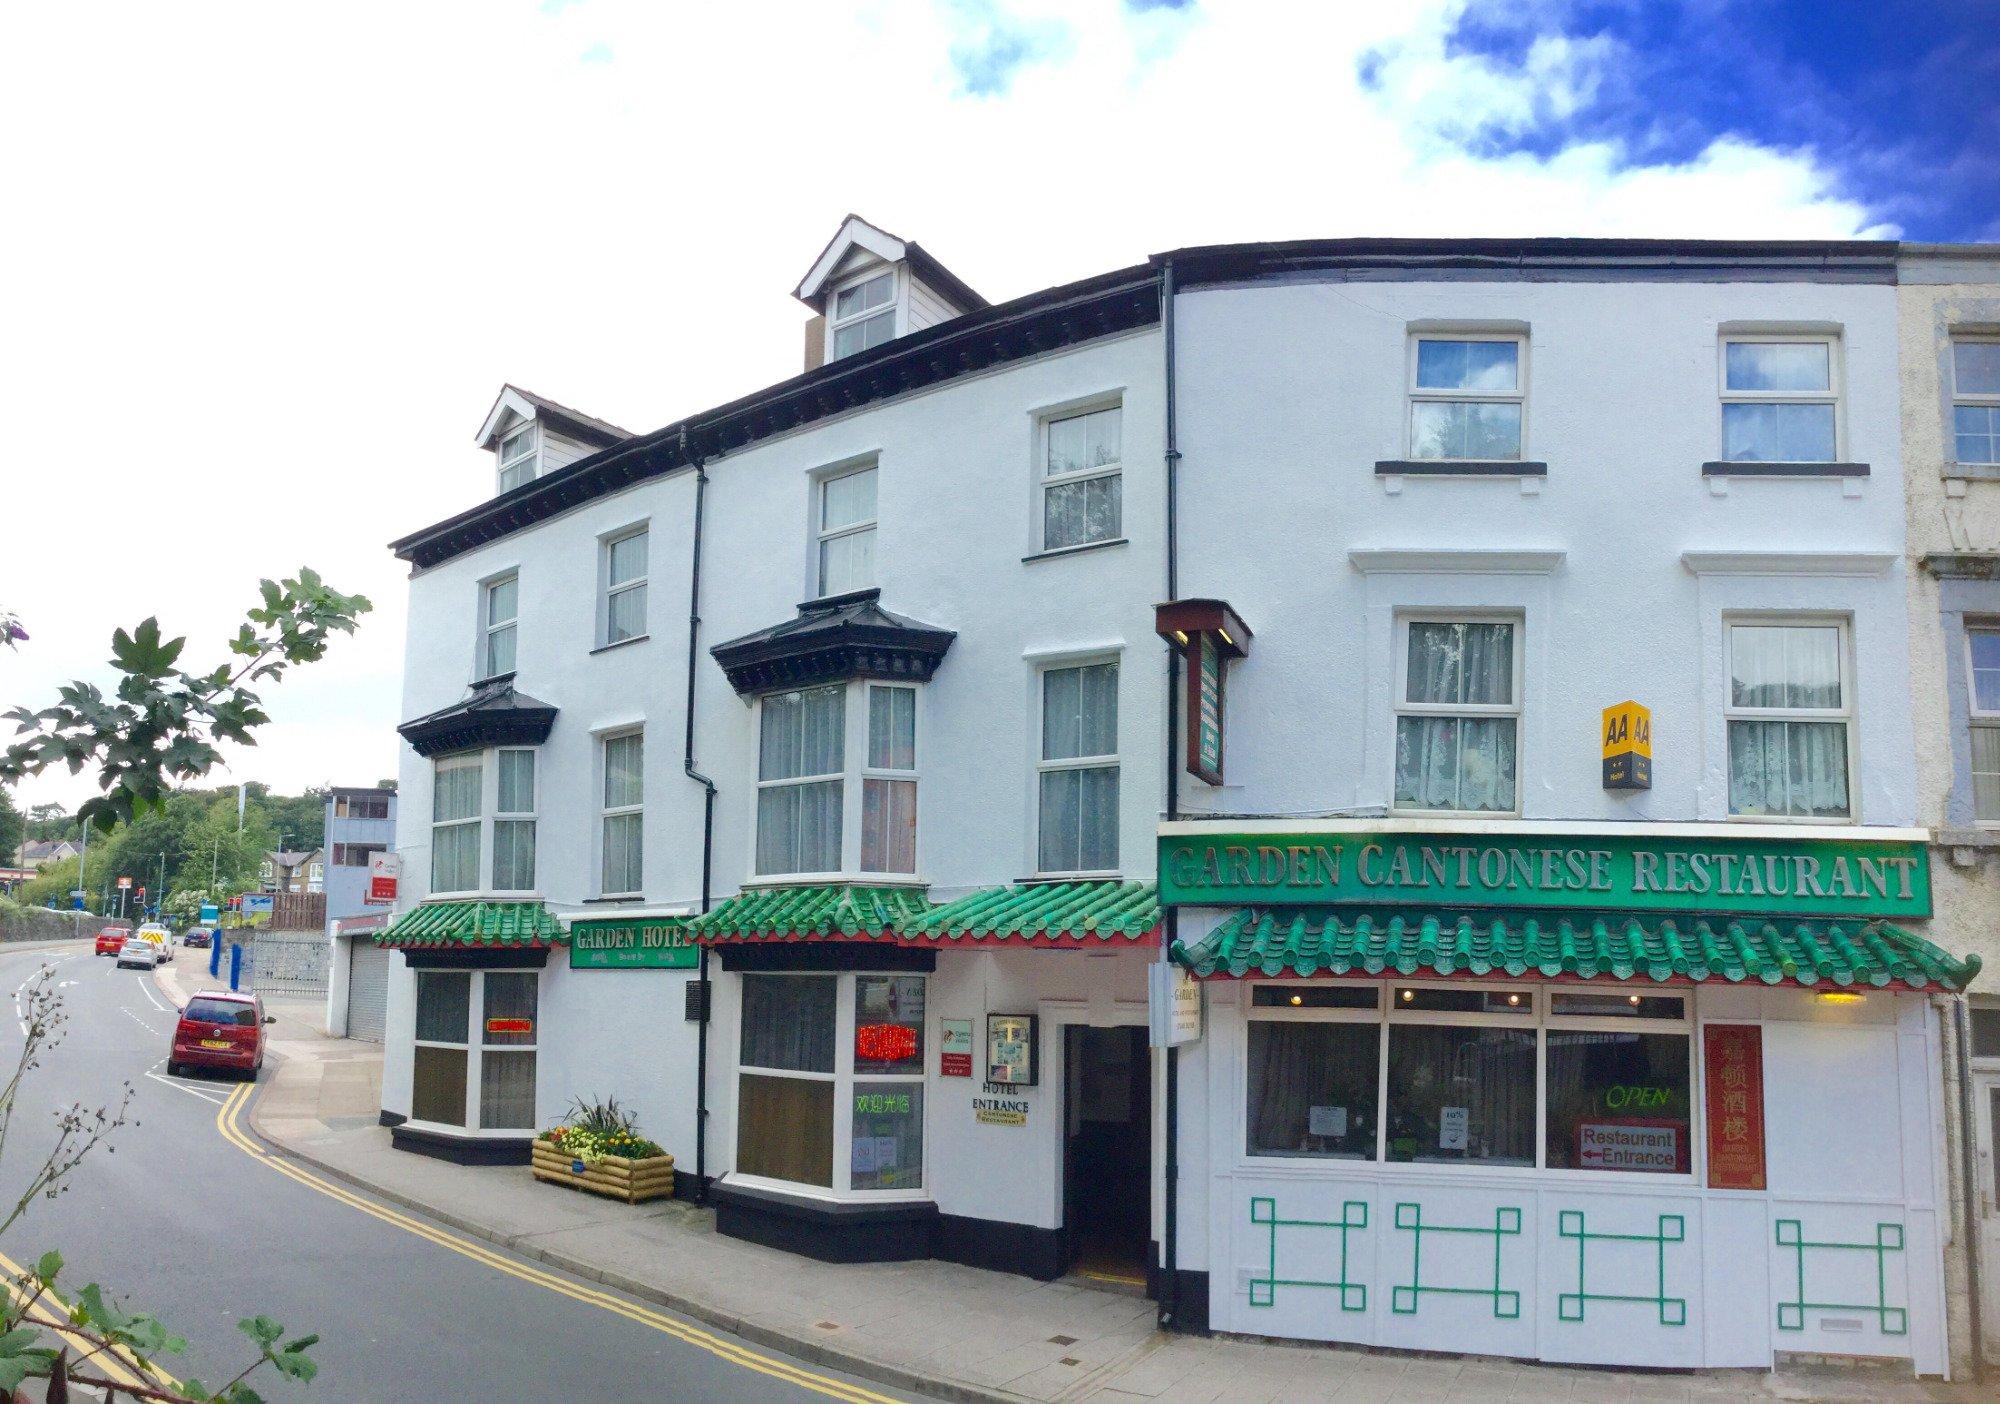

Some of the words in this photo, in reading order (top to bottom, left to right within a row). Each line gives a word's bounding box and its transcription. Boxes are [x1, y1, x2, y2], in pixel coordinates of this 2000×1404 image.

[1605, 713, 1628, 747] AA
[1633, 715, 1650, 746] AA
[1169, 845, 1343, 888] GARDEN
[1357, 845, 1612, 891] CANTONESE
[1632, 851, 1917, 899] RESTAURANT
[577, 927, 636, 949] GARDEN
[982, 1082, 1019, 1096] HOTEL
[1606, 1086, 1672, 1109] OPEN
[856, 1094, 910, 1114] 欢迎光临
[972, 1099, 1029, 1113] ENTRANCE
[1583, 1128, 1673, 1147] Restaurant
[1602, 1148, 1674, 1165] Entrance
